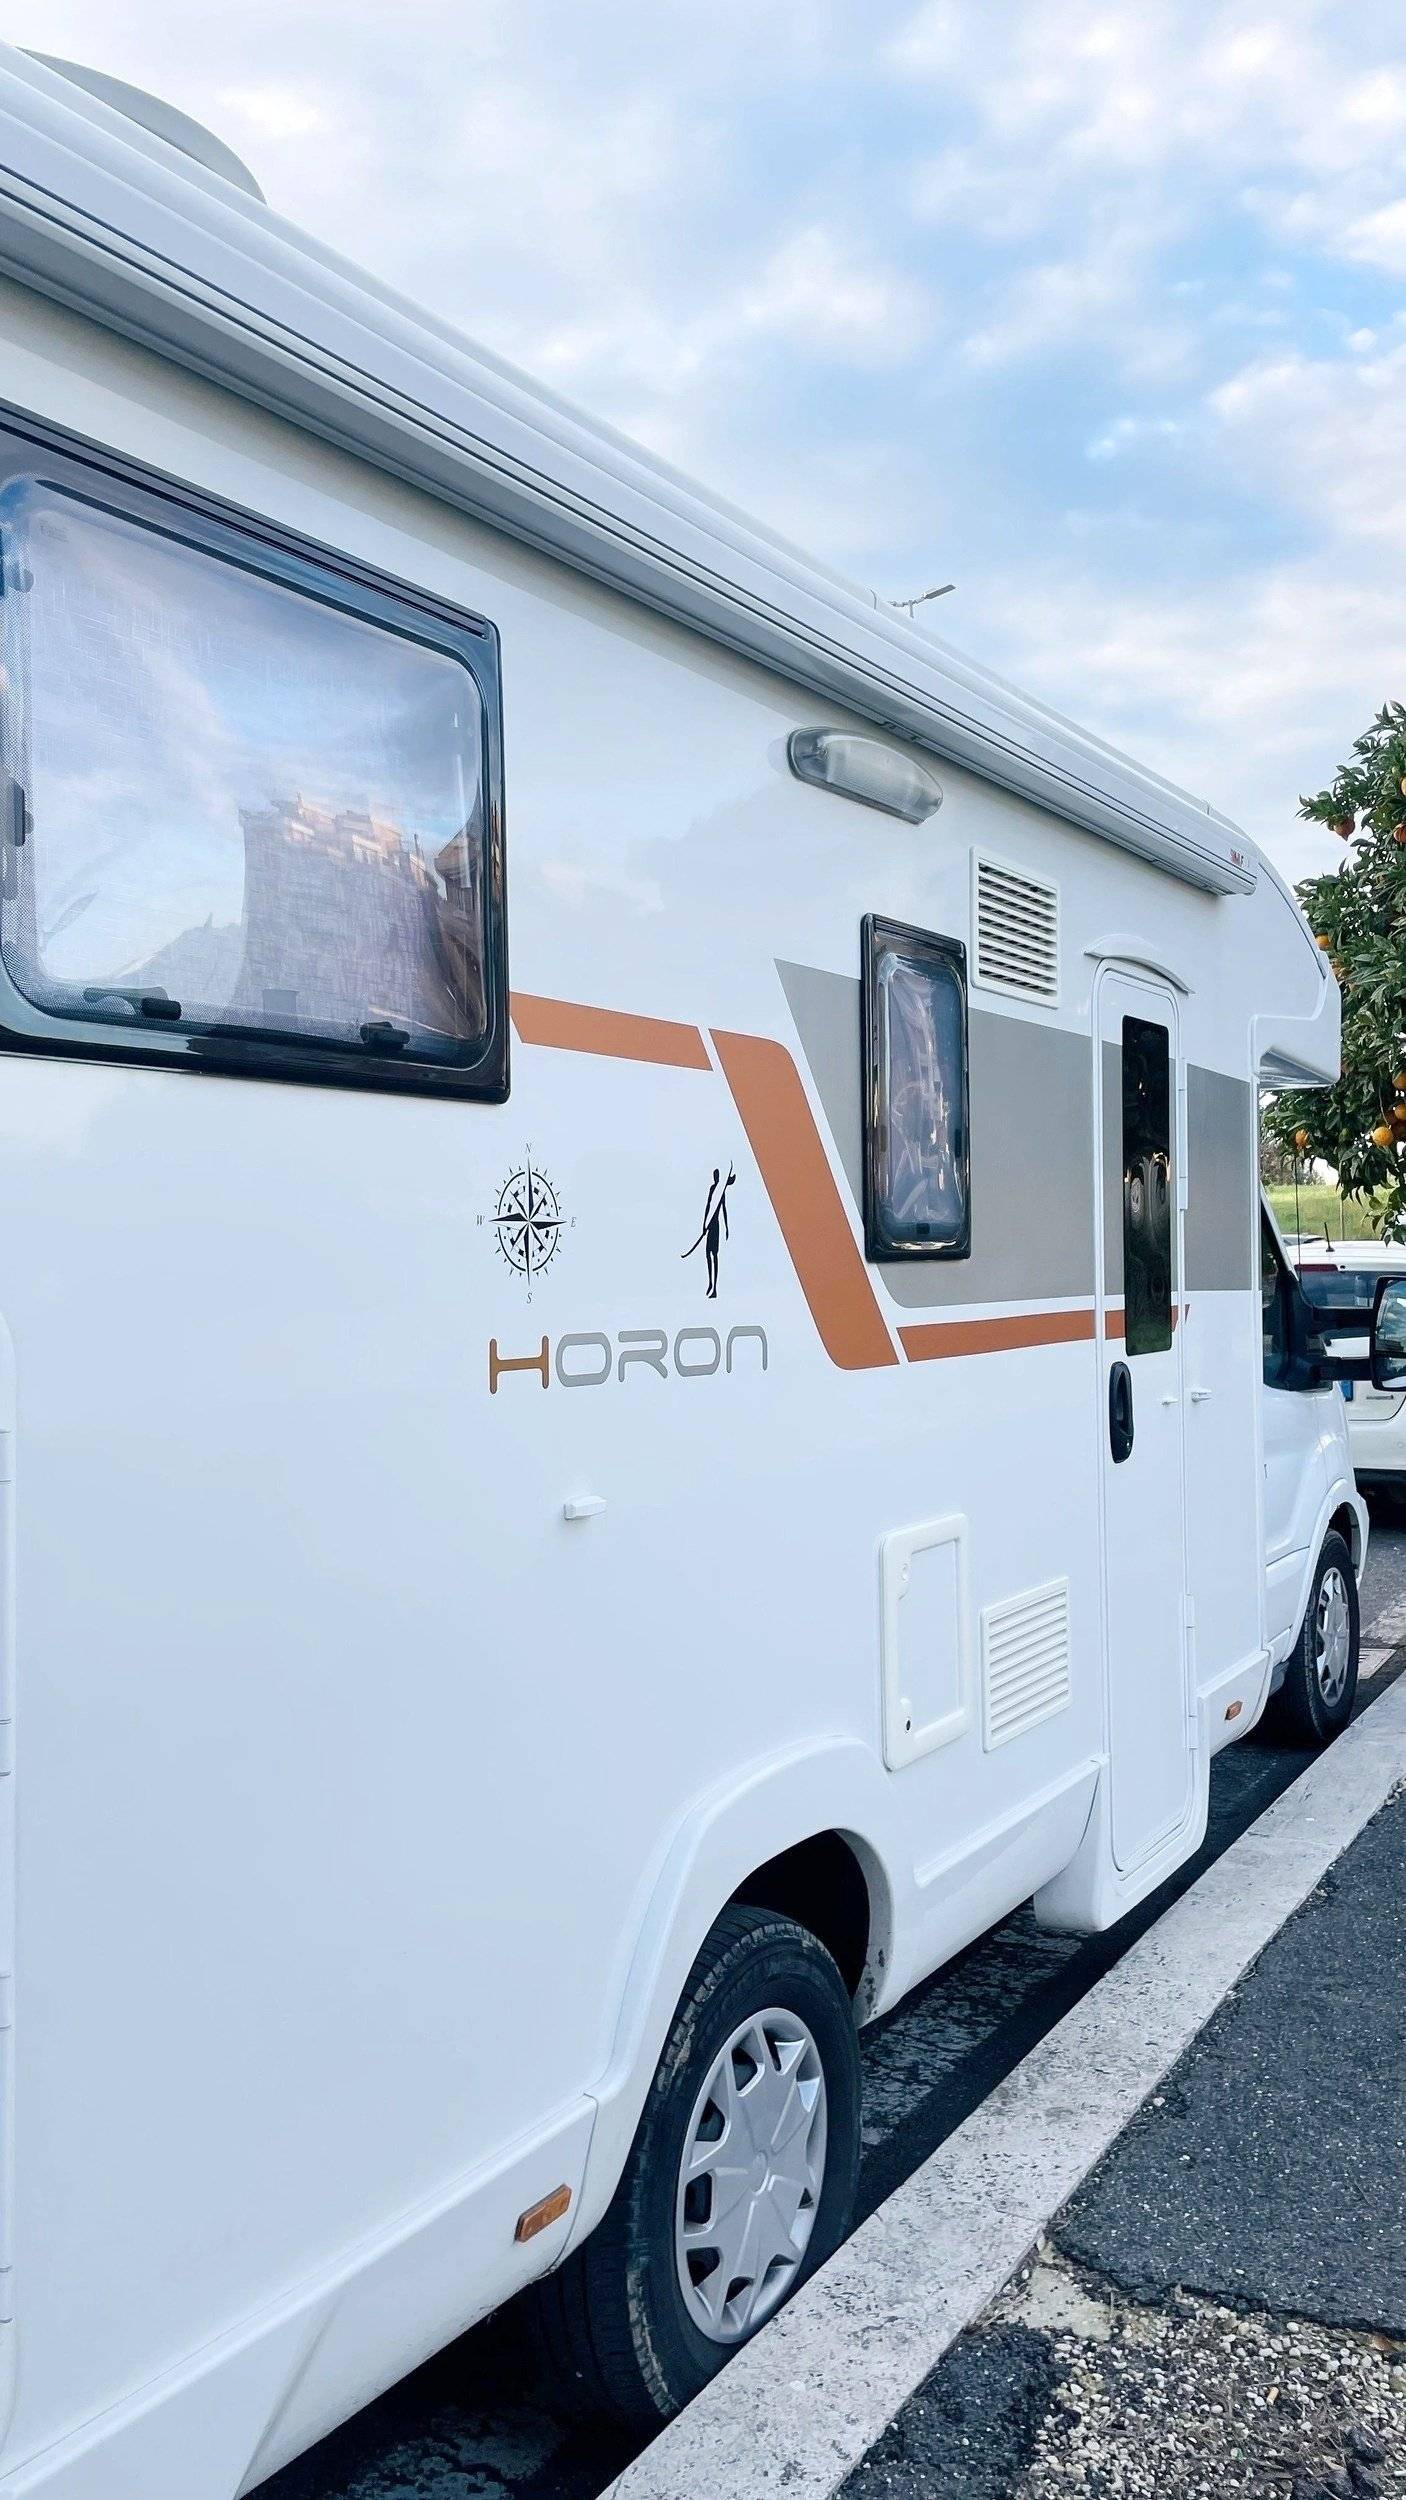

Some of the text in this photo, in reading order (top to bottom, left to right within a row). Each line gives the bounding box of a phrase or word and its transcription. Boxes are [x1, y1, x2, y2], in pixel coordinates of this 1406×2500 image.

[525, 1142, 532, 1154] N
[476, 1214, 485, 1226] W
[570, 1216, 577, 1228] E
[526, 1292, 533, 1304] S
